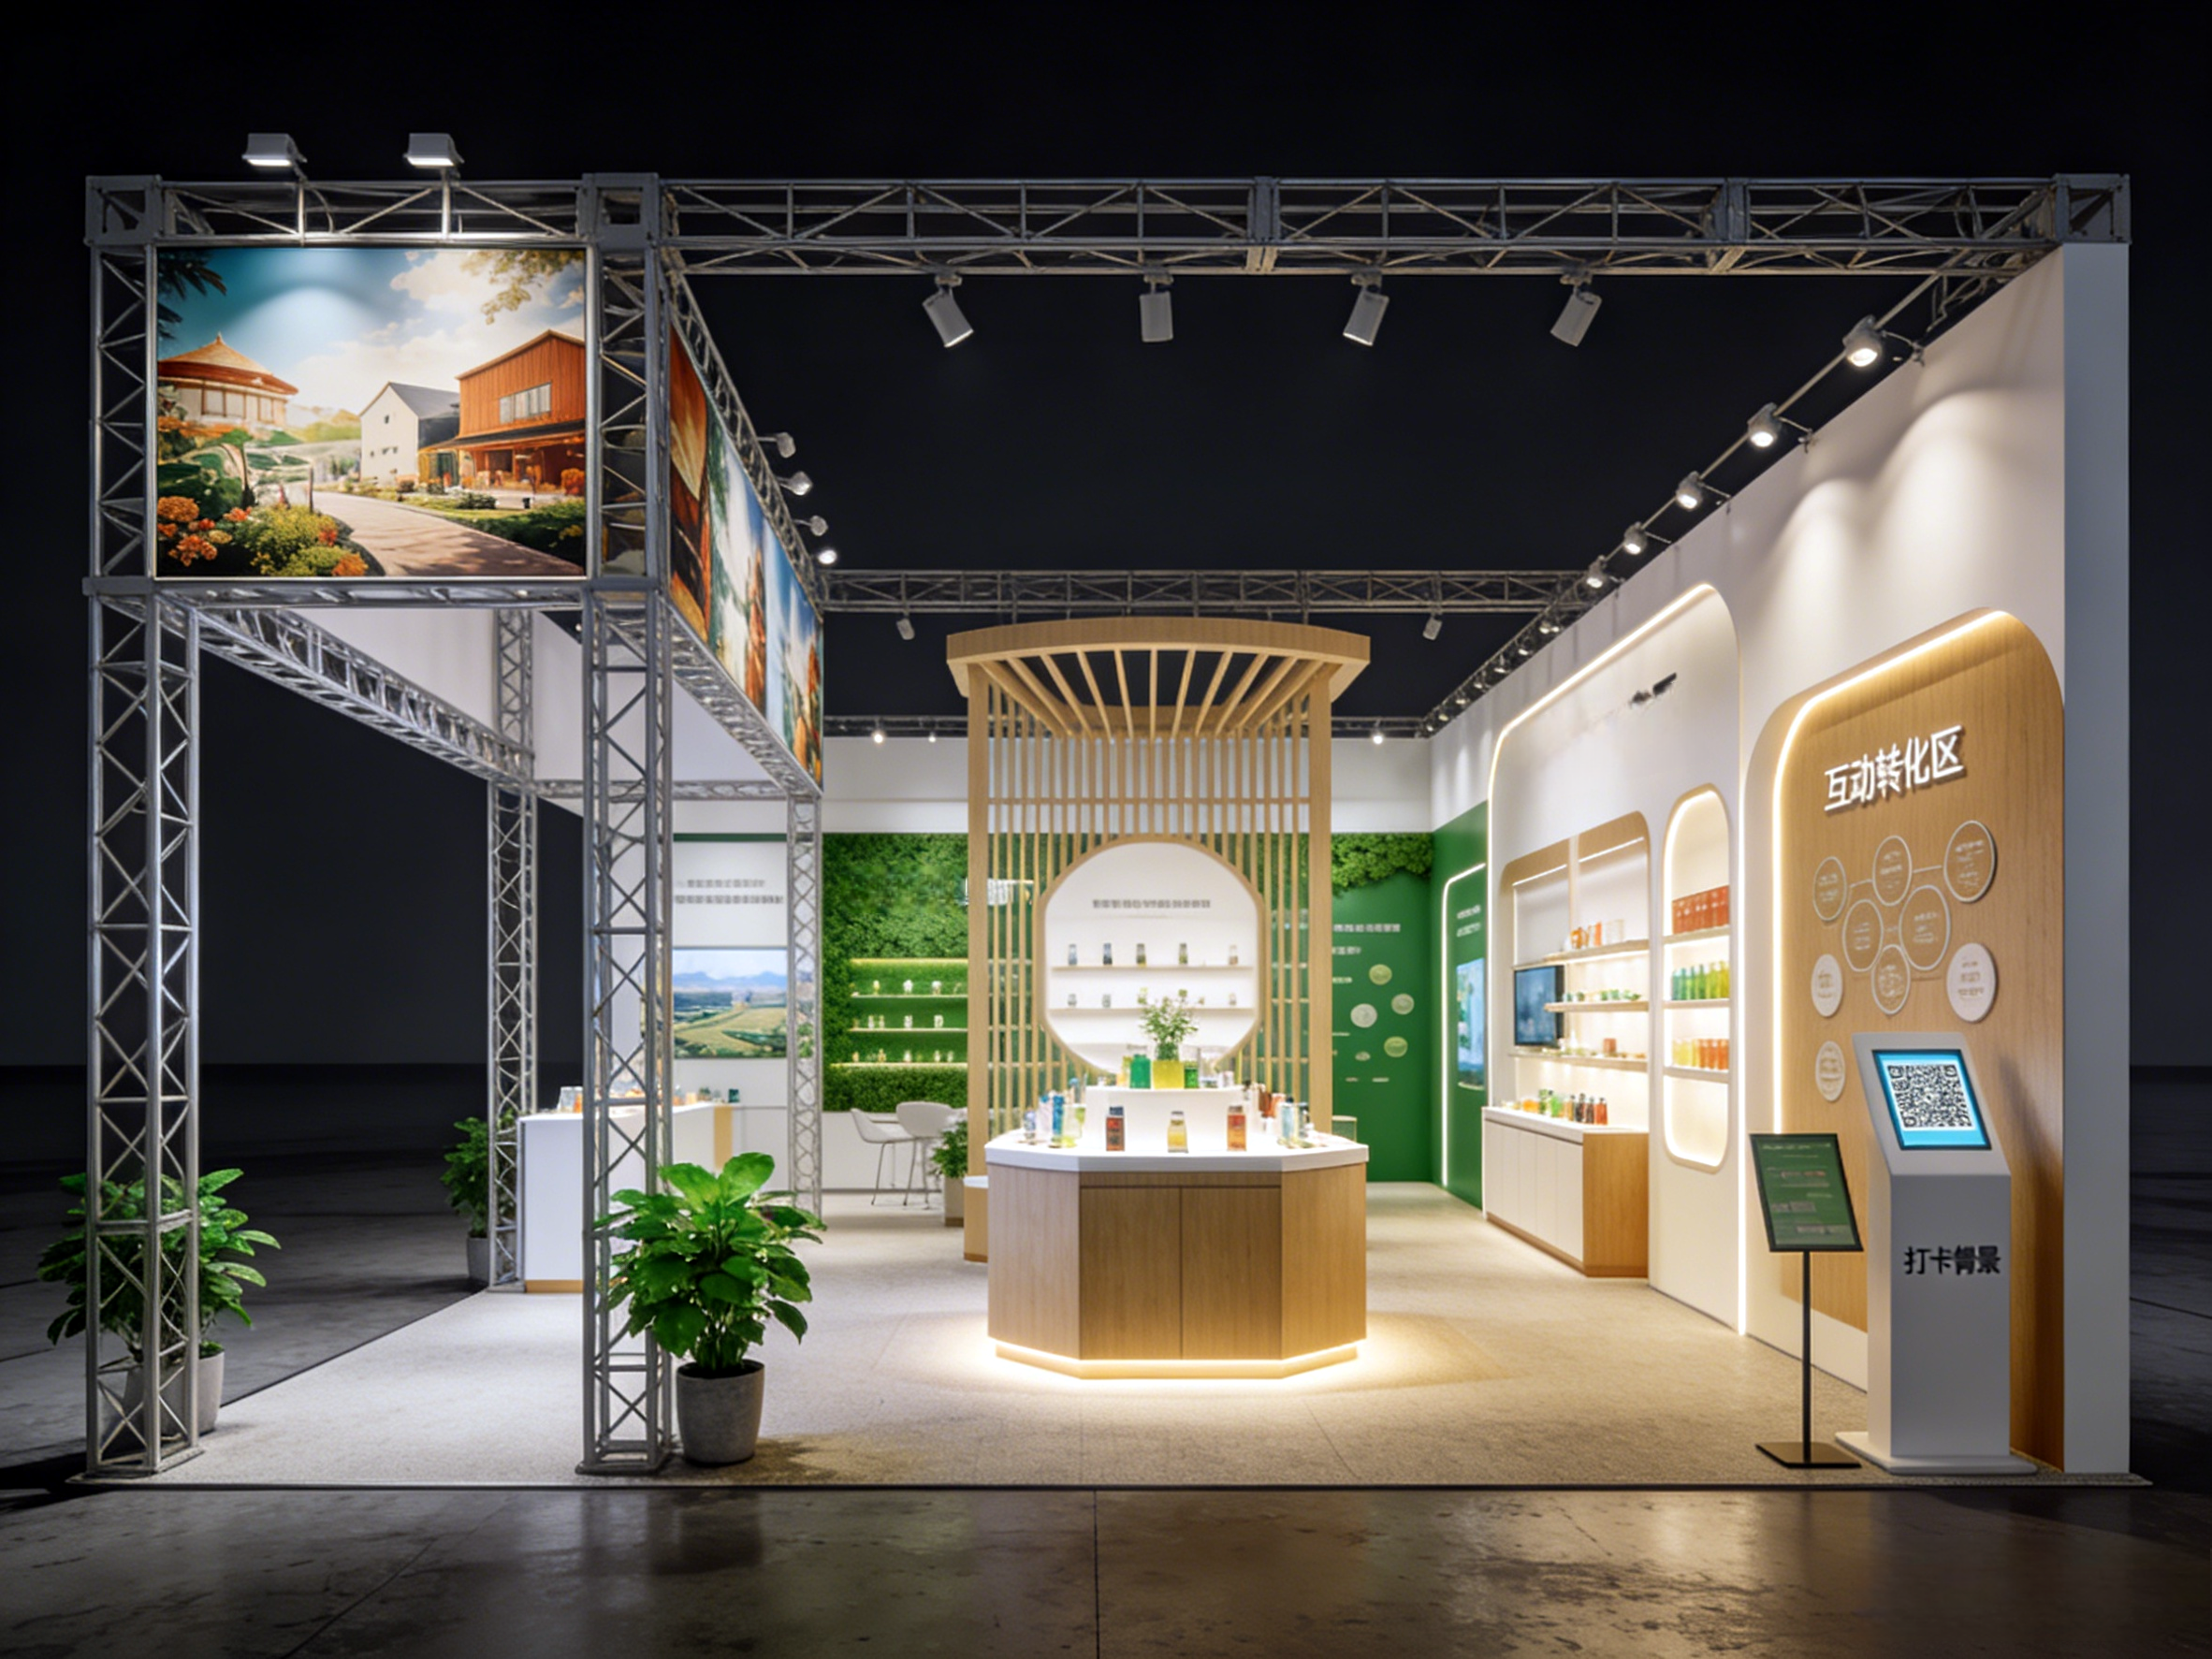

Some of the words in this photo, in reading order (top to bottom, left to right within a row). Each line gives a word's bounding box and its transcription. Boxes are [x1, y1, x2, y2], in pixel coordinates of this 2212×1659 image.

[1825, 725, 1964, 811] 互动转化区
